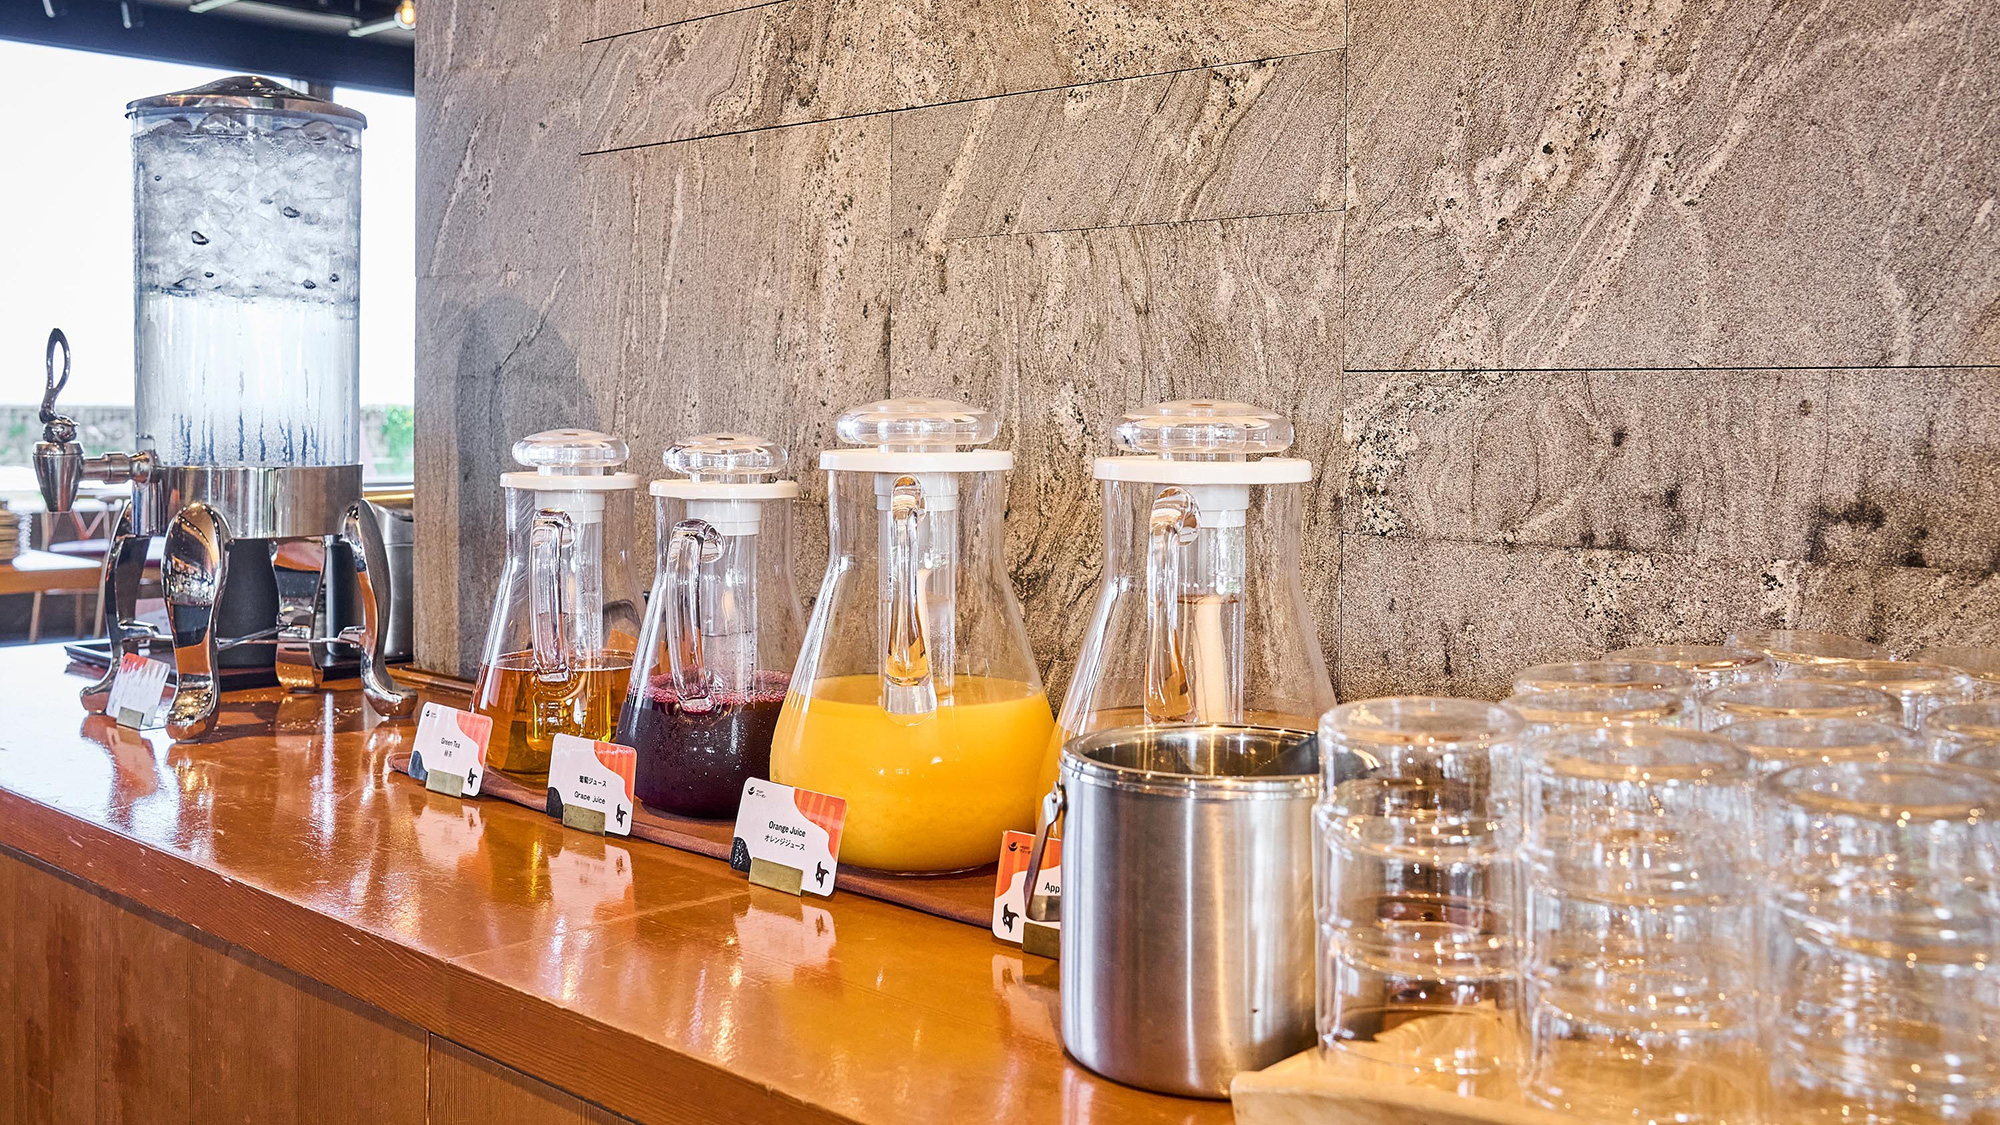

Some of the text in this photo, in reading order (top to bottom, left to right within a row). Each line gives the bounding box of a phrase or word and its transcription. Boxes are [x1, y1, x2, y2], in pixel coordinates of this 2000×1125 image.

[441, 737, 453, 746] Green
[768, 820, 806, 837] Orange Juice
[764, 834, 805, 850] オレンジジュース
[1044, 882, 1060, 894] App
